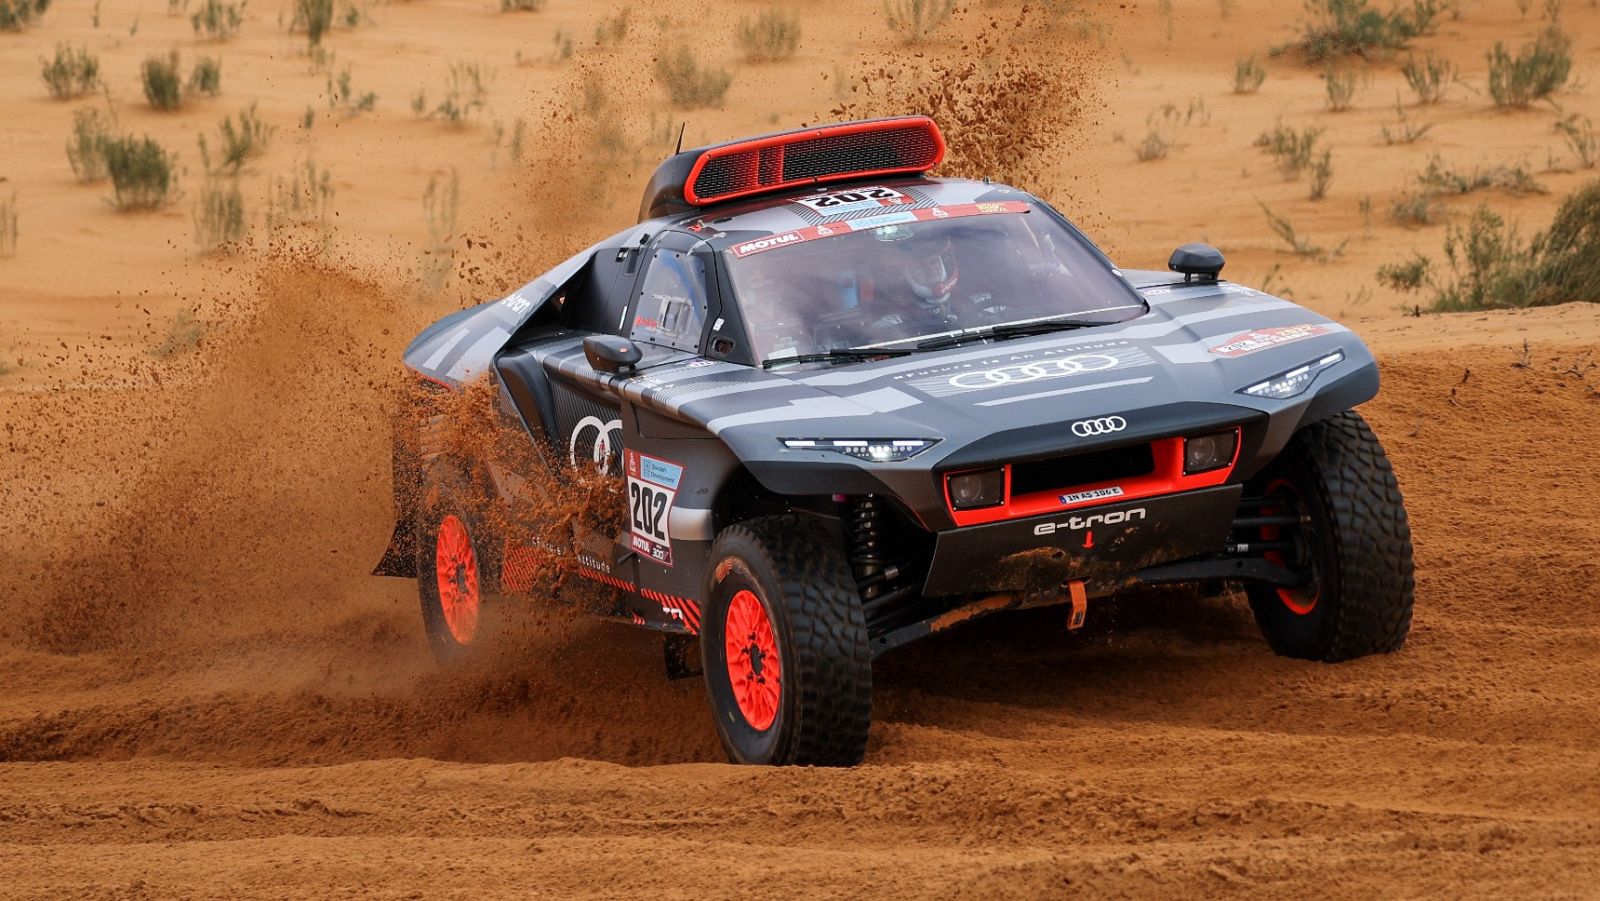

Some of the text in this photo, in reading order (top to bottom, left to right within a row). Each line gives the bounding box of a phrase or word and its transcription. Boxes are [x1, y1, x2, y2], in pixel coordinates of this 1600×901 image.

[739, 233, 799, 254] MOTUL
[1044, 340, 1129, 356] Attitude
[1081, 491, 1093, 499] AS
[1095, 488, 1112, 497] 106
[630, 482, 668, 541] 202
[1033, 507, 1146, 536] e-tron
[633, 535, 651, 553] MOTUL
